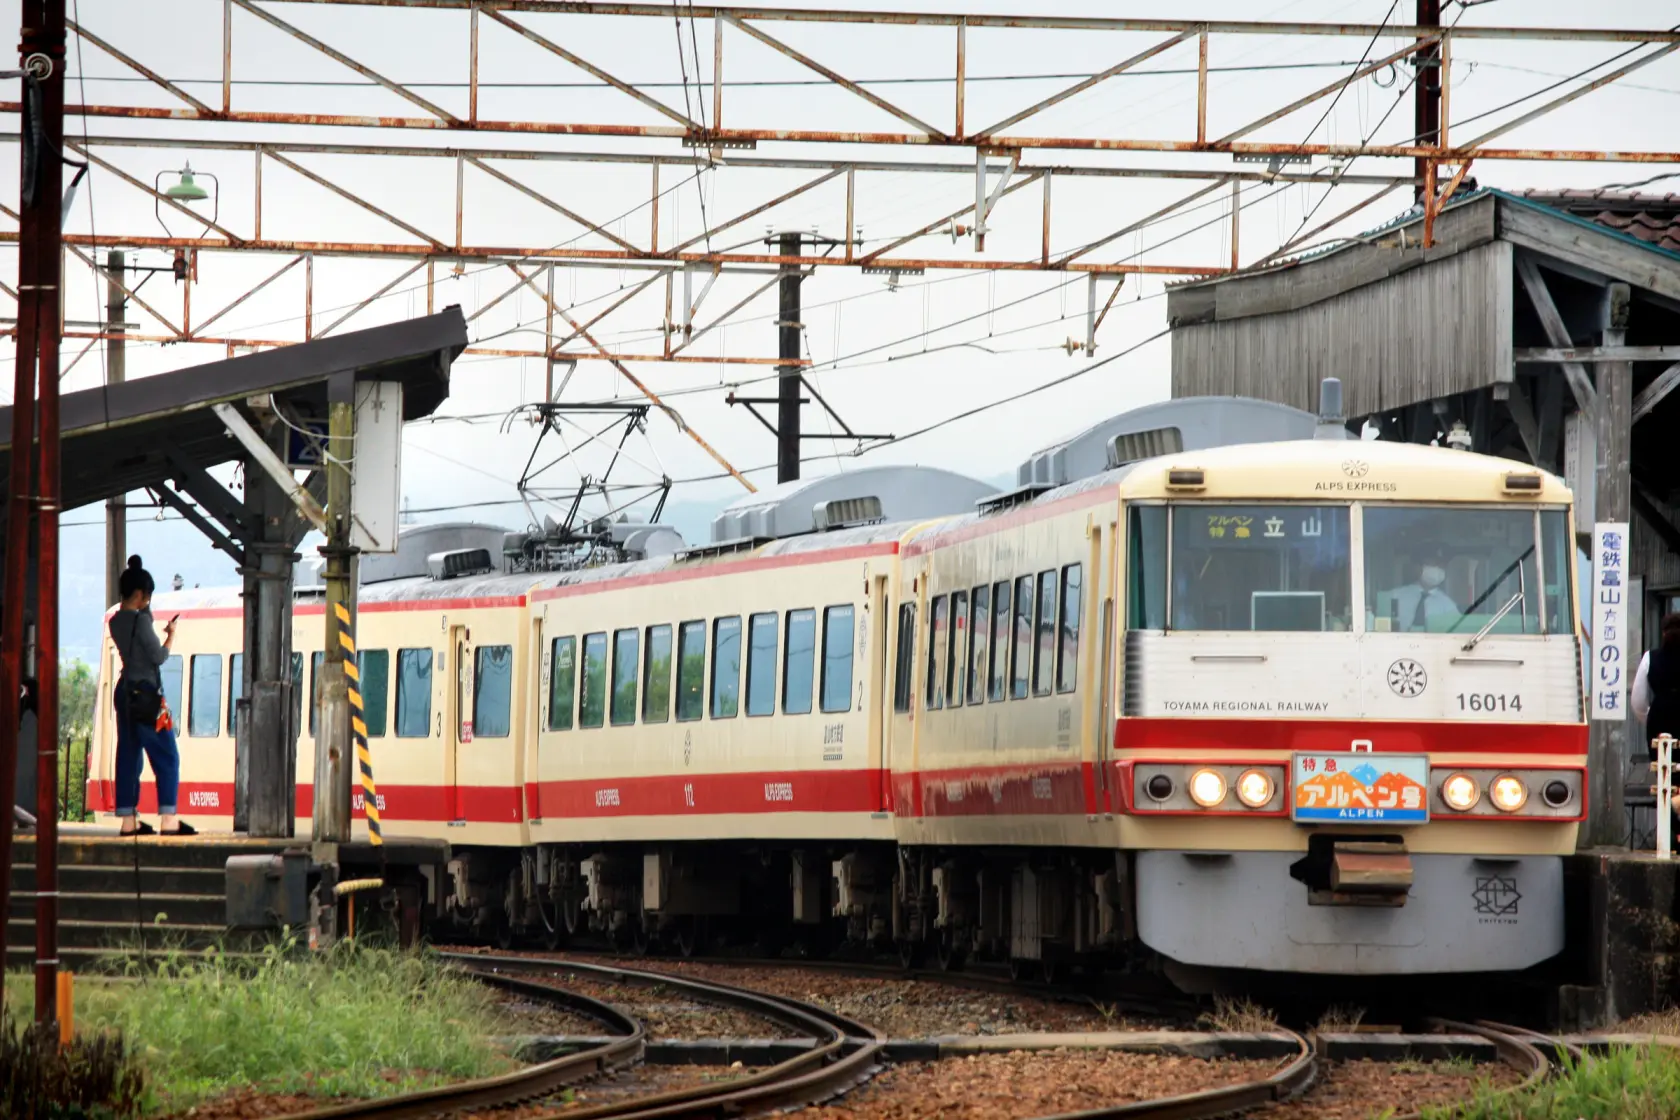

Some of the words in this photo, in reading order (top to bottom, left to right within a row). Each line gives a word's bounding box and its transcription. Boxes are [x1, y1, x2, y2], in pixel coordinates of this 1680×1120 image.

[1315, 482, 1344, 491] ALPS
[1347, 482, 1397, 492] EXPRESS
[1263, 516, 1322, 537] 立山
[1164, 701, 1209, 711] TOYAMA
[1213, 701, 1272, 711] REGIONAL
[1278, 702, 1329, 712] RAILWAY
[1456, 693, 1523, 712] 16014
[1302, 757, 1337, 772] 特急
[189, 791, 200, 807] ALPS
[200, 791, 220, 807] EXPRESS
[352, 794, 364, 810] ALPS
[1303, 784, 1421, 808] アルペン号
[1339, 808, 1385, 818] ALPEN
